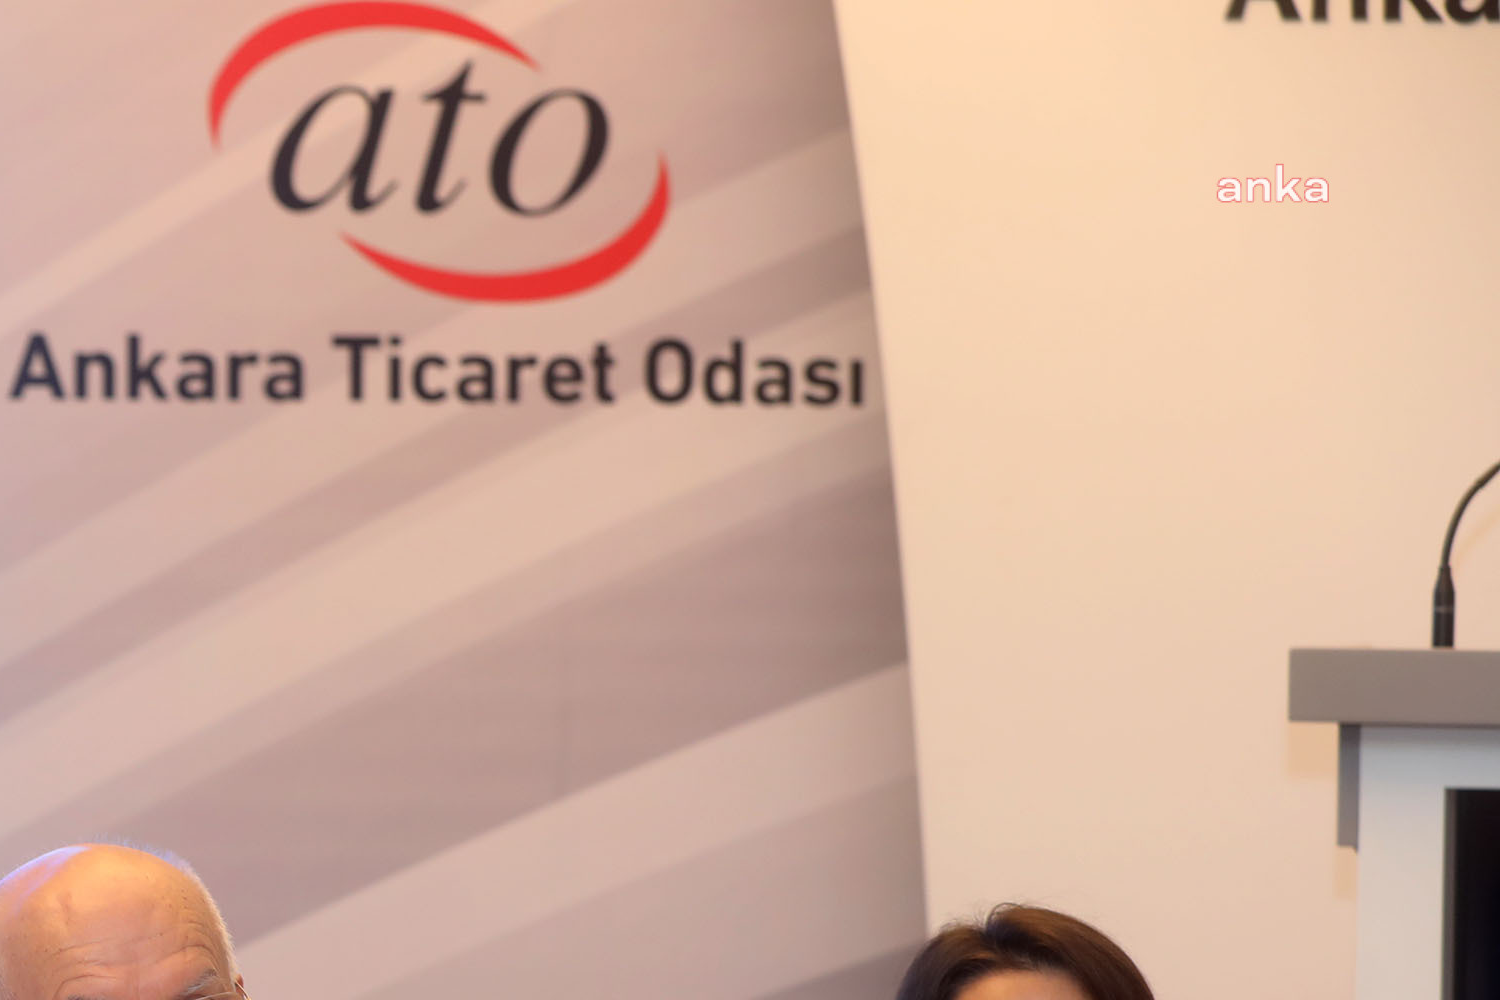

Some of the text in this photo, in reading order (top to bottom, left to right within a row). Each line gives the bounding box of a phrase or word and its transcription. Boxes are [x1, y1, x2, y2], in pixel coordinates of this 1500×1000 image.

[268, 59, 610, 218] ato
[11, 332, 865, 407] Ankara Ticaret Odası
